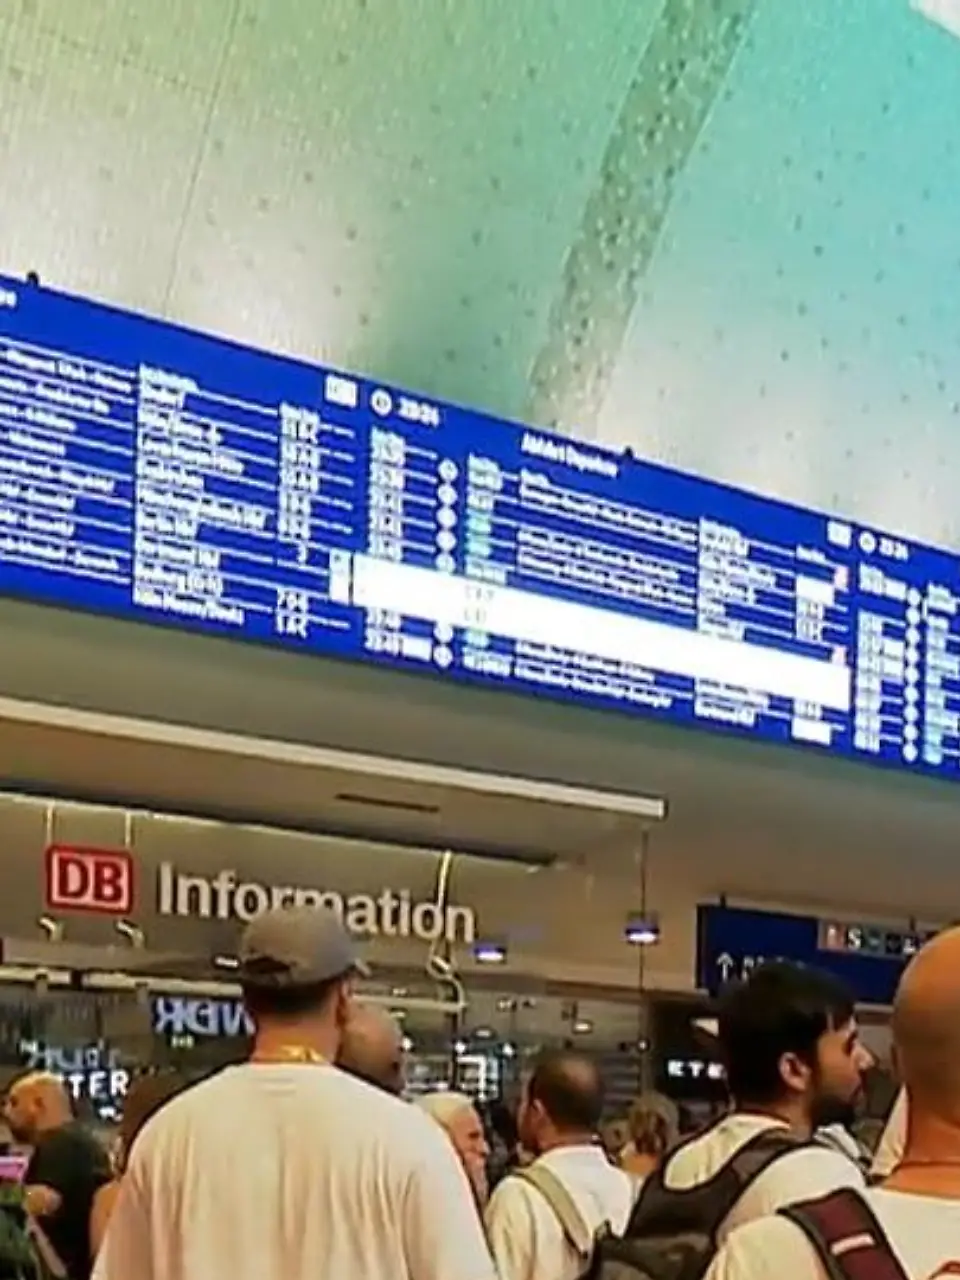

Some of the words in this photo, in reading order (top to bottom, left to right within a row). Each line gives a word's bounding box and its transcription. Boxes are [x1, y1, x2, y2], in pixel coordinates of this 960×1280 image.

[58, 857, 124, 902] DB
[157, 861, 476, 943] Information
[60, 1069, 130, 1100] TER
